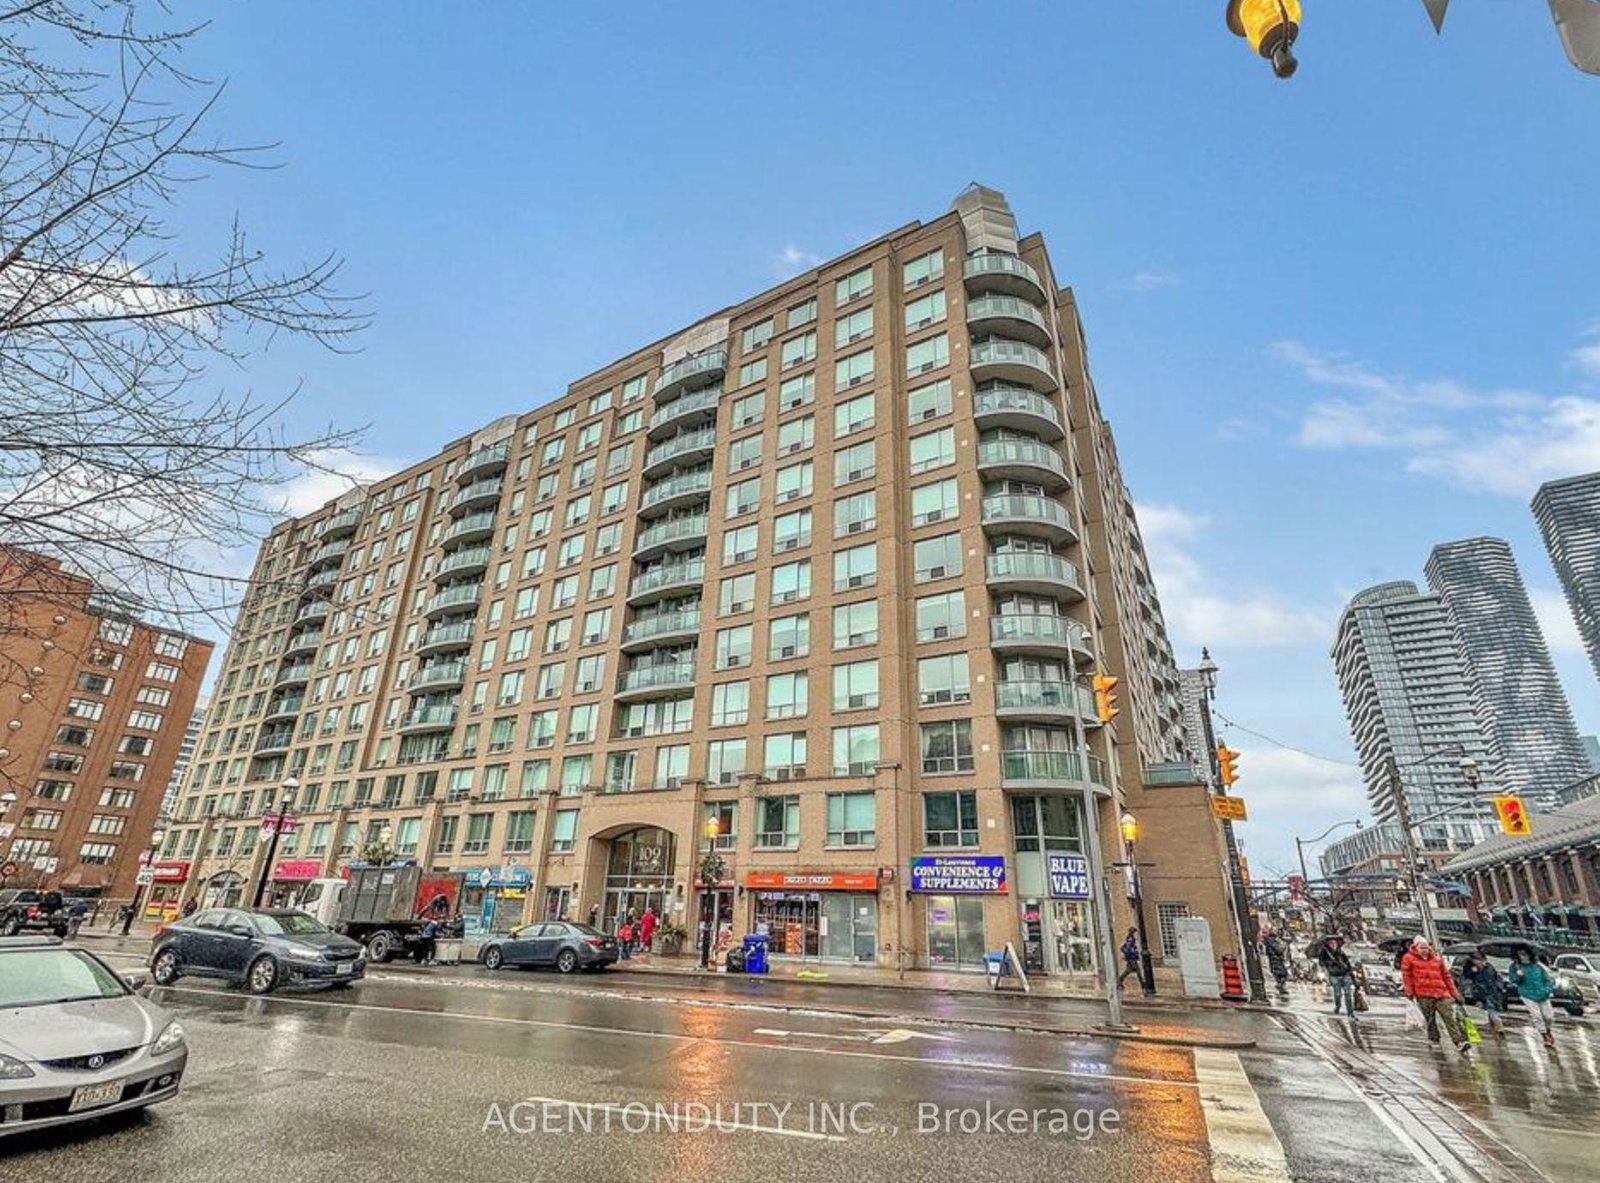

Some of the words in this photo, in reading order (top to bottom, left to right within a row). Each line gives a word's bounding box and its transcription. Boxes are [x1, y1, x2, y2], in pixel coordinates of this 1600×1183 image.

[640, 847, 661, 861] 109
[1051, 858, 1086, 872] BLUE
[139, 873, 152, 882] 40
[913, 866, 990, 877] CONVENIENCE
[992, 866, 1004, 877] &
[920, 878, 998, 889] SUPPLEMENTS
[1052, 875, 1088, 893] VAPE
